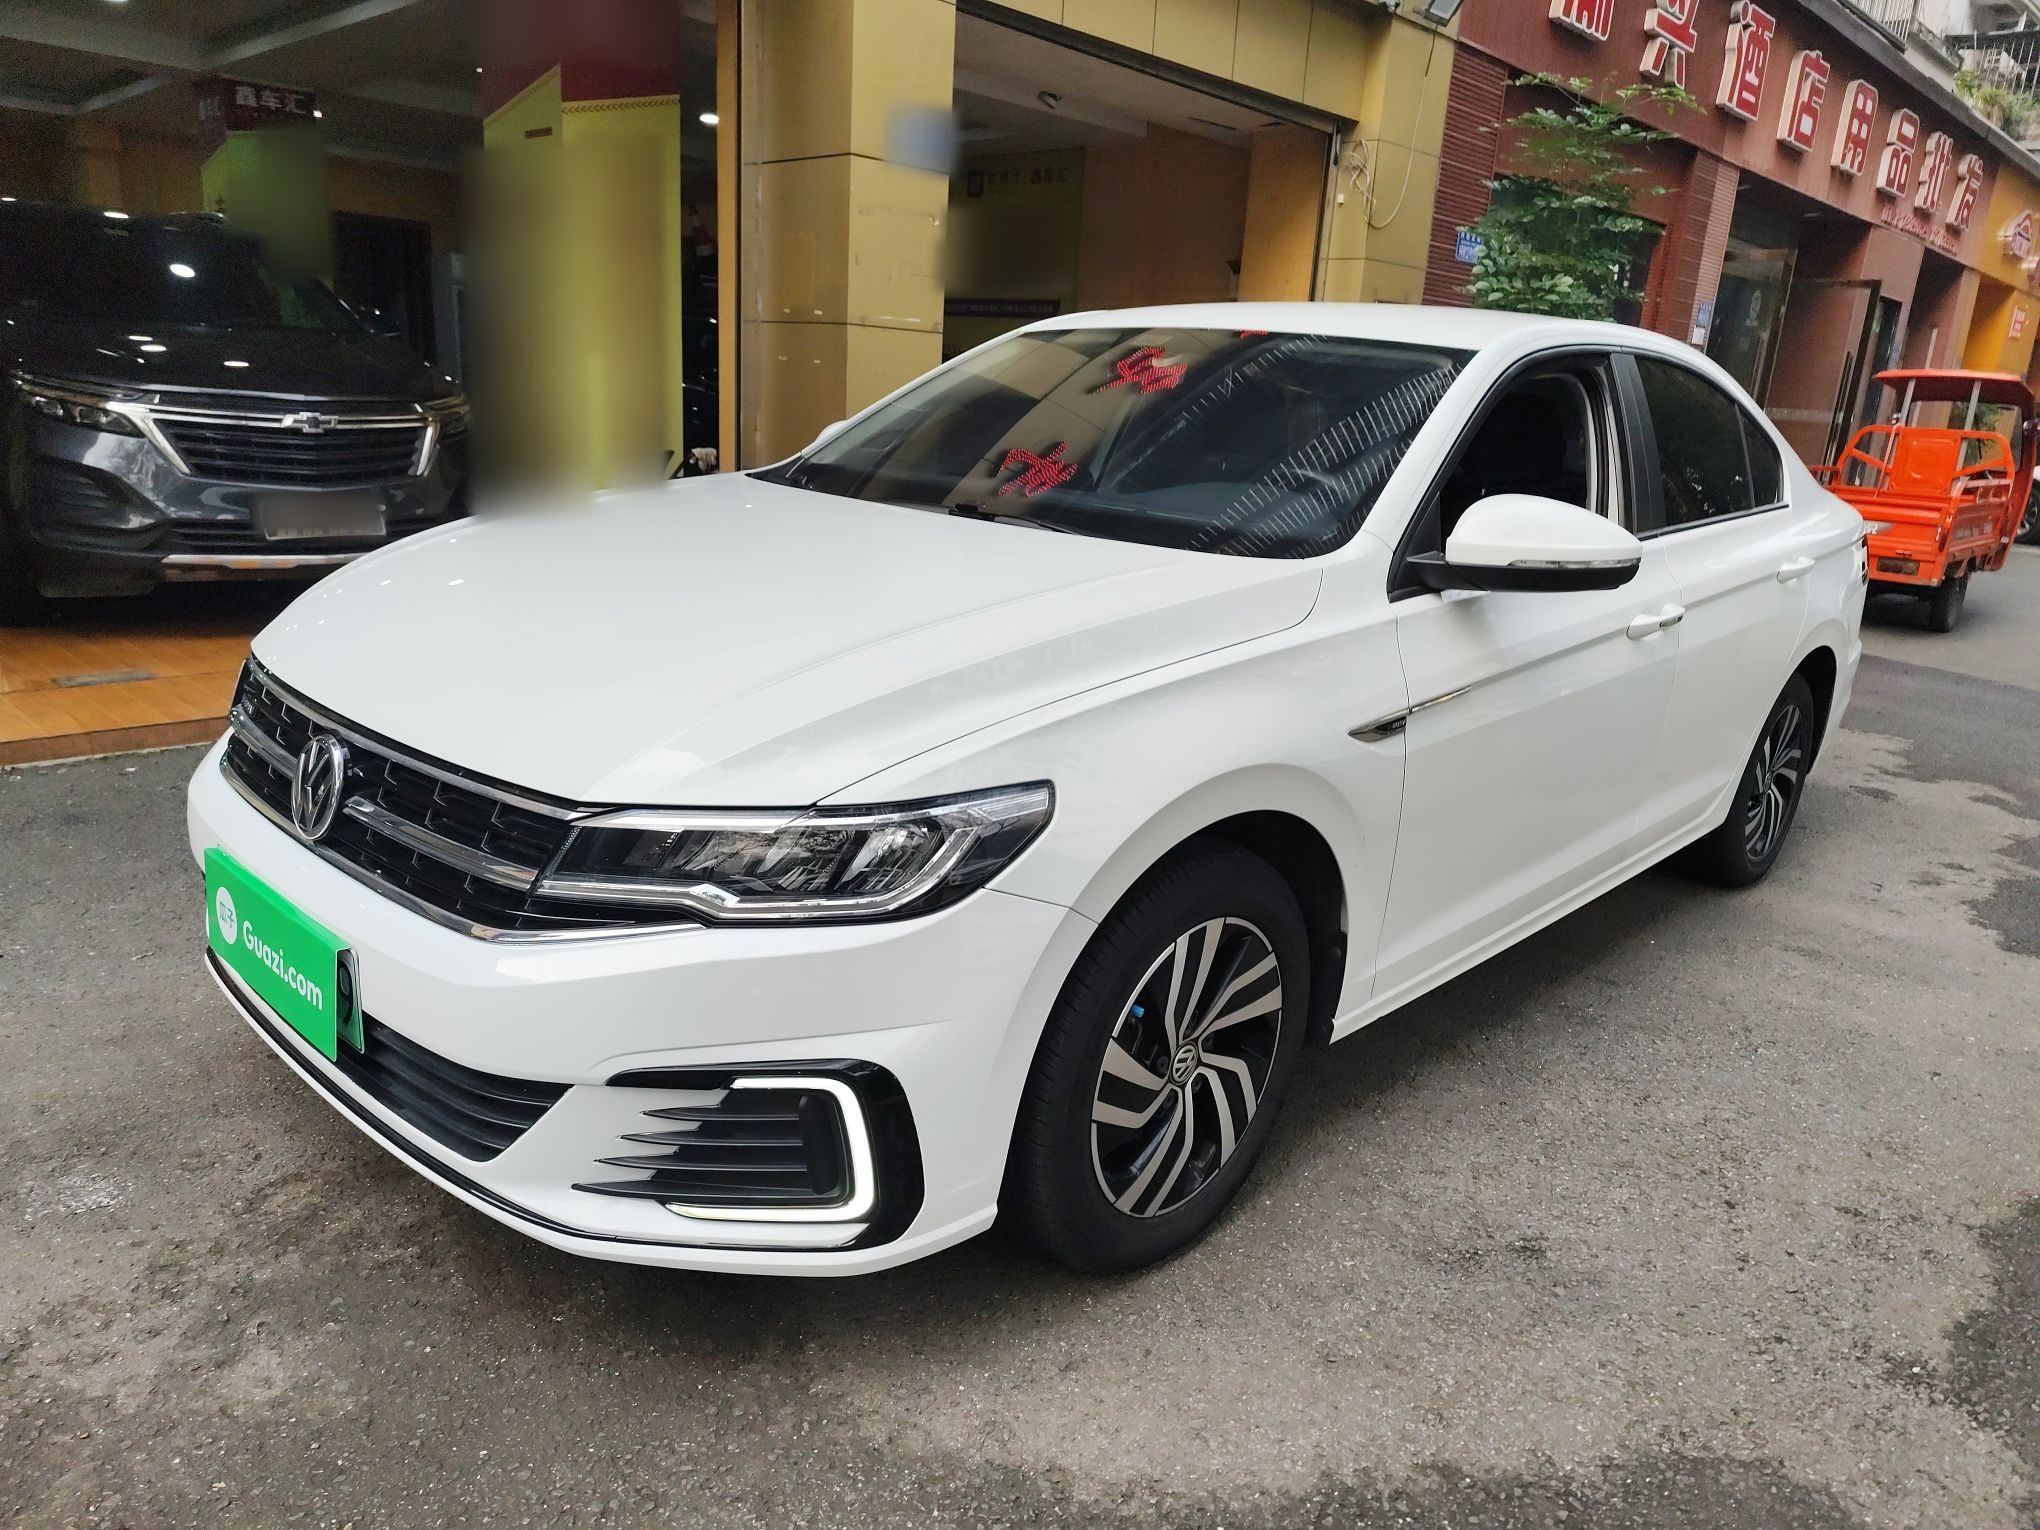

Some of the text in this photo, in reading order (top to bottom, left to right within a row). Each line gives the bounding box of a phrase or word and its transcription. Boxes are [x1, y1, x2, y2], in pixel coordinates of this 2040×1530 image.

[1549, 0, 1984, 232] 兴酒店用品批发
[242, 920, 323, 1011] Guazi.com
